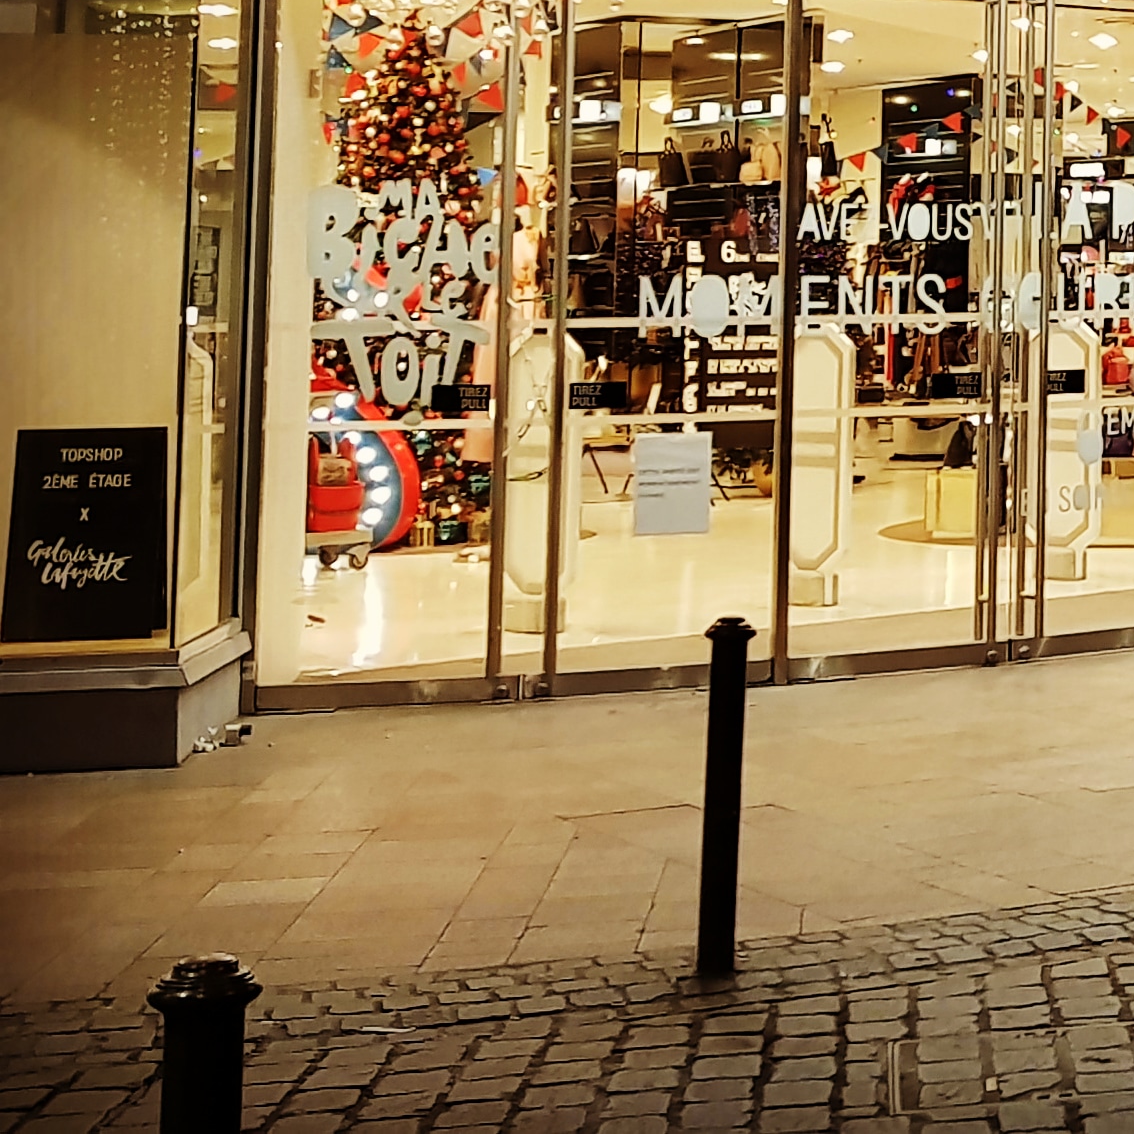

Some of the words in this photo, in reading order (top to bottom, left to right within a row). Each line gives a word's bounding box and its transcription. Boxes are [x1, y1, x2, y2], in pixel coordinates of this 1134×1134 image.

[379, 178, 442, 219] MA
[797, 202, 973, 241] AVE-VOUS
[638, 273, 946, 339] MOMENTS
[458, 387, 488, 398] TIREZ
[572, 396, 598, 407] PULL
[573, 385, 602, 396] TIREZ
[461, 398, 487, 409] PULL
[60, 448, 123, 463] TOPSHOP
[27, 537, 100, 567] Galeries
[41, 552, 133, 590] Lafayette
